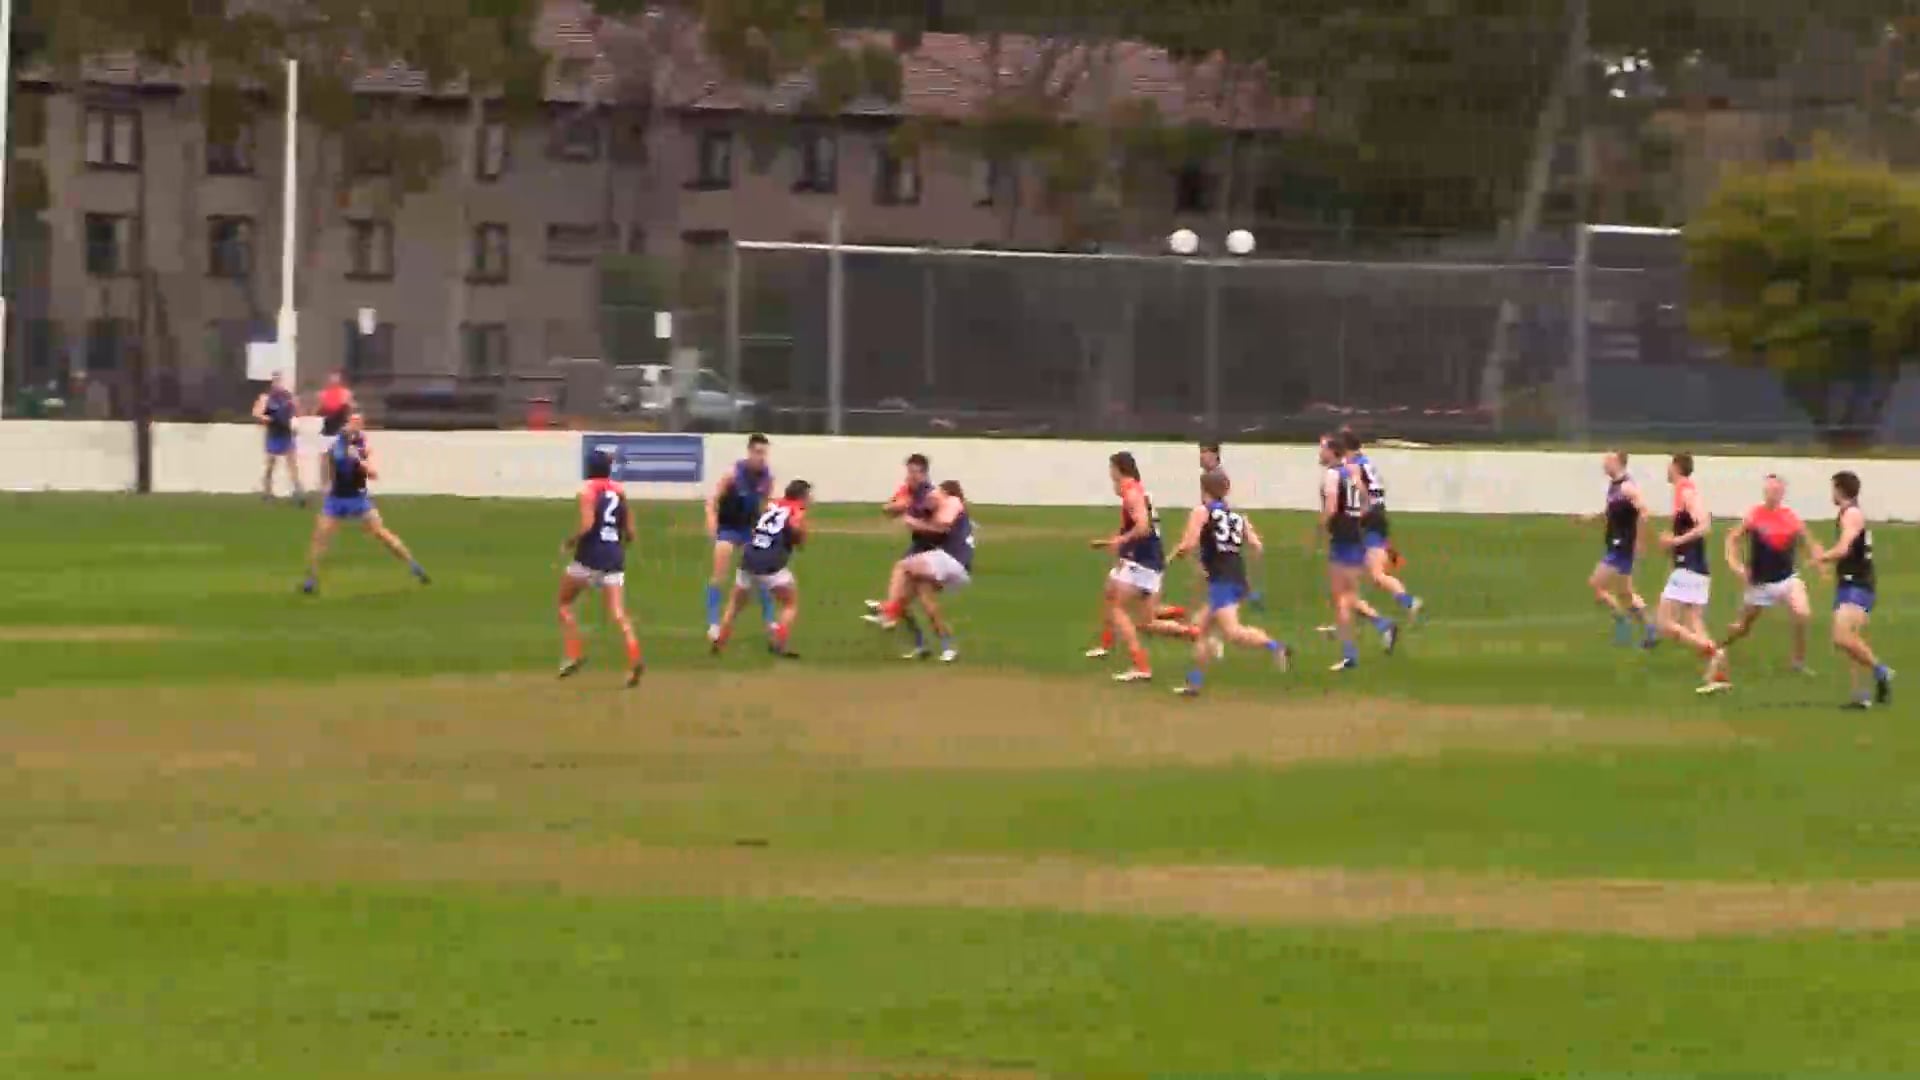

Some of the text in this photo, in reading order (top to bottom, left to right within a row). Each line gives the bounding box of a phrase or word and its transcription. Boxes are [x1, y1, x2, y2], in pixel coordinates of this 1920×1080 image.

[604, 490, 620, 524] 2
[756, 502, 790, 535] 23
[1211, 508, 1244, 545] 33
